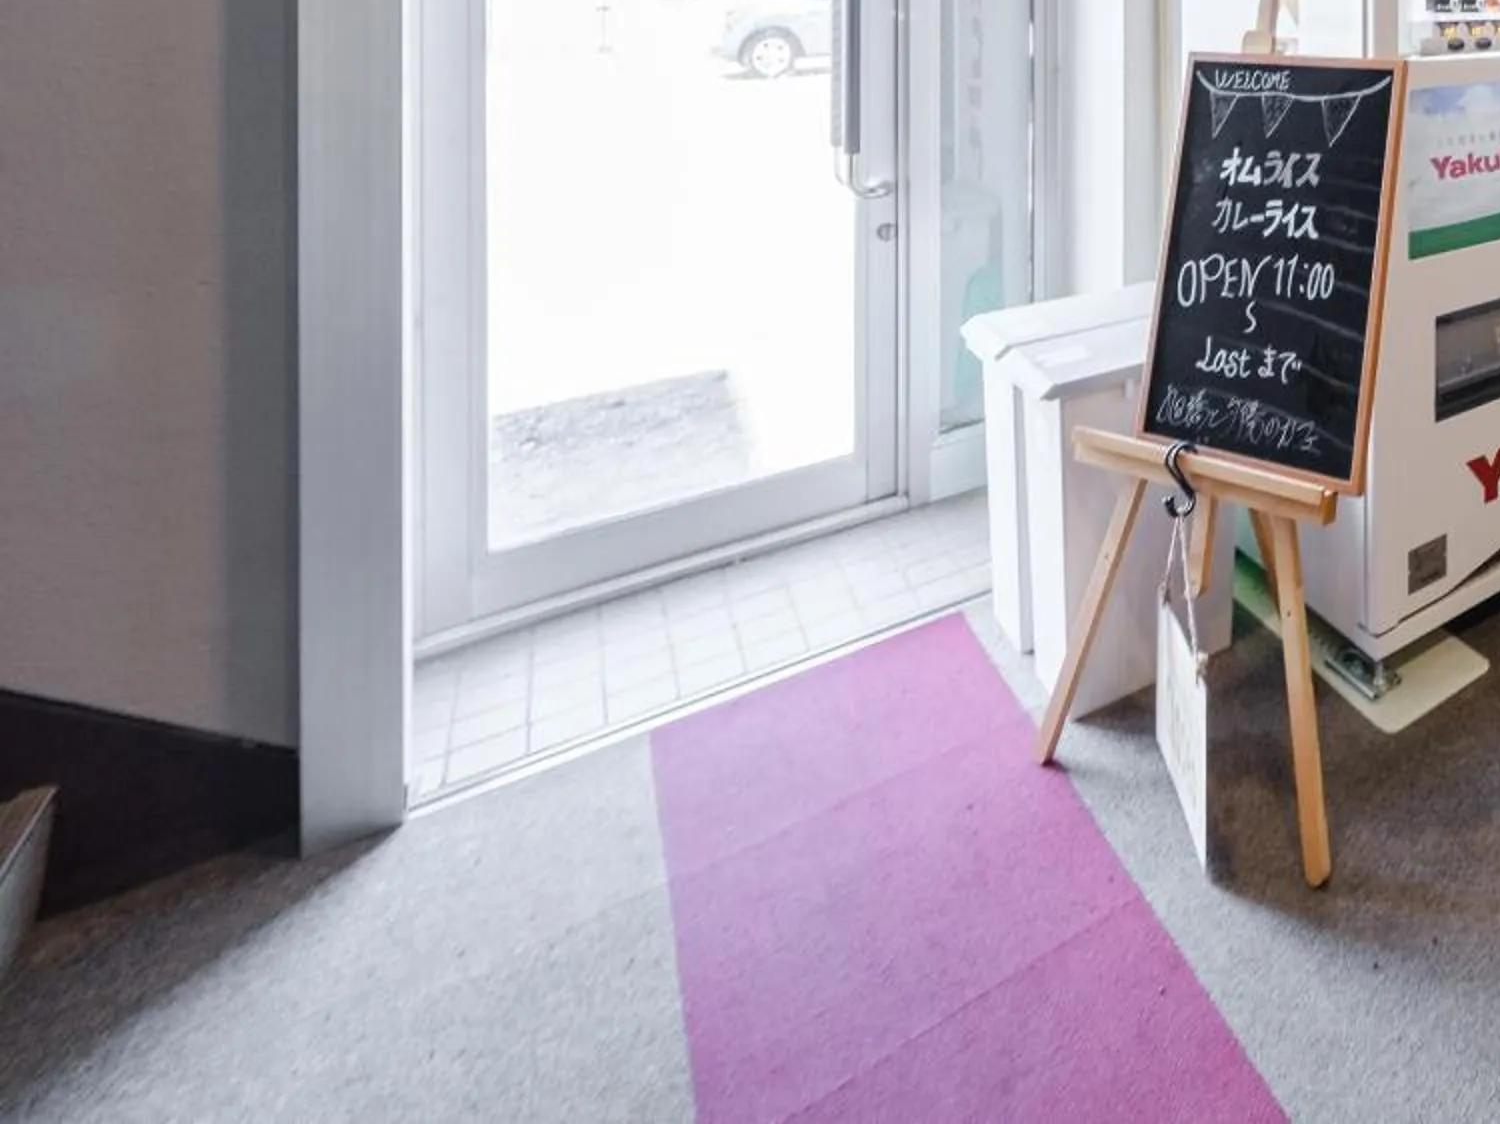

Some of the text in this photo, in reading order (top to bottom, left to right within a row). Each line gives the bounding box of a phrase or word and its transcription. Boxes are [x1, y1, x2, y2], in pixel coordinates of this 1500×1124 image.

[1215, 69, 1291, 90] WELCOME
[1219, 146, 1323, 189] オムライス
[1211, 196, 1320, 239] カレーライス
[1176, 253, 1336, 308] OPEN 11:00
